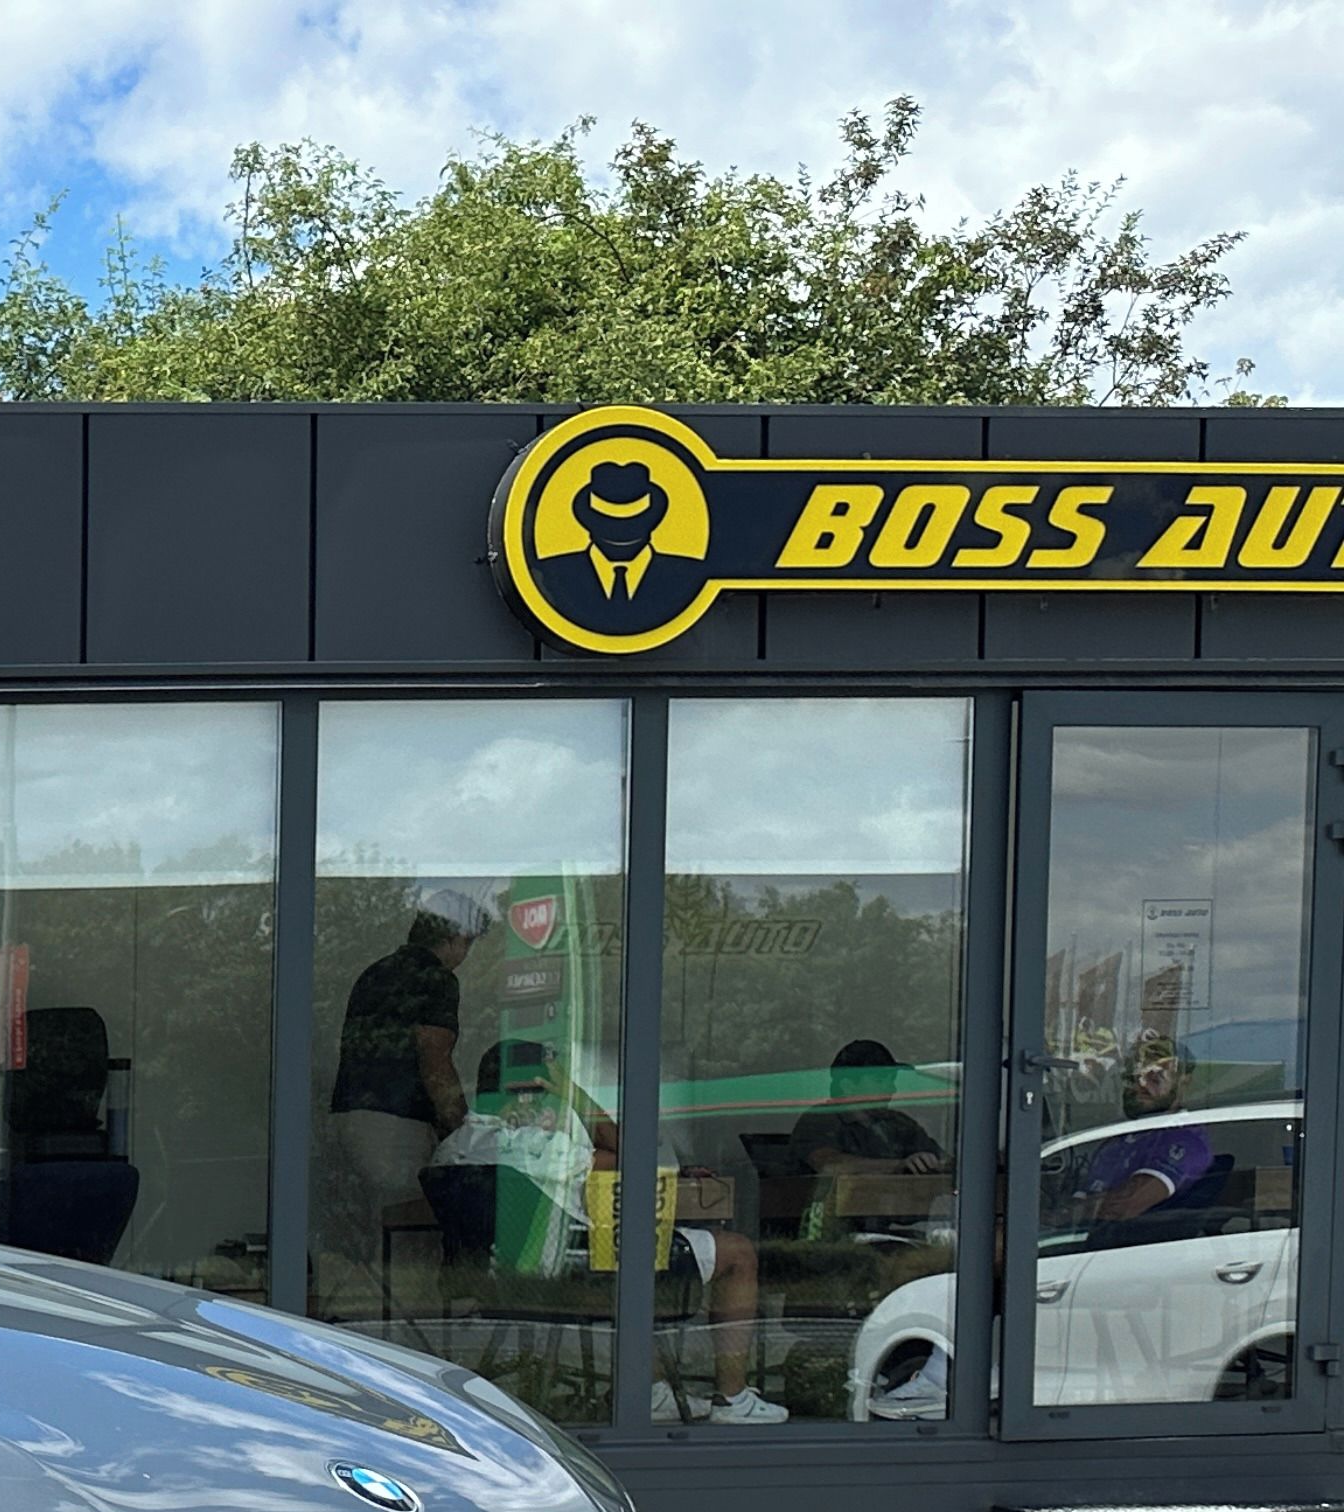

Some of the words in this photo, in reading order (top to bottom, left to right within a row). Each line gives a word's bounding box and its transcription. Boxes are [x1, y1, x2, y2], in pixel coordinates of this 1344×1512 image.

[776, 484, 1114, 568] BOSS
[1136, 486, 1344, 568] AU
[680, 919, 823, 956] AUTO
